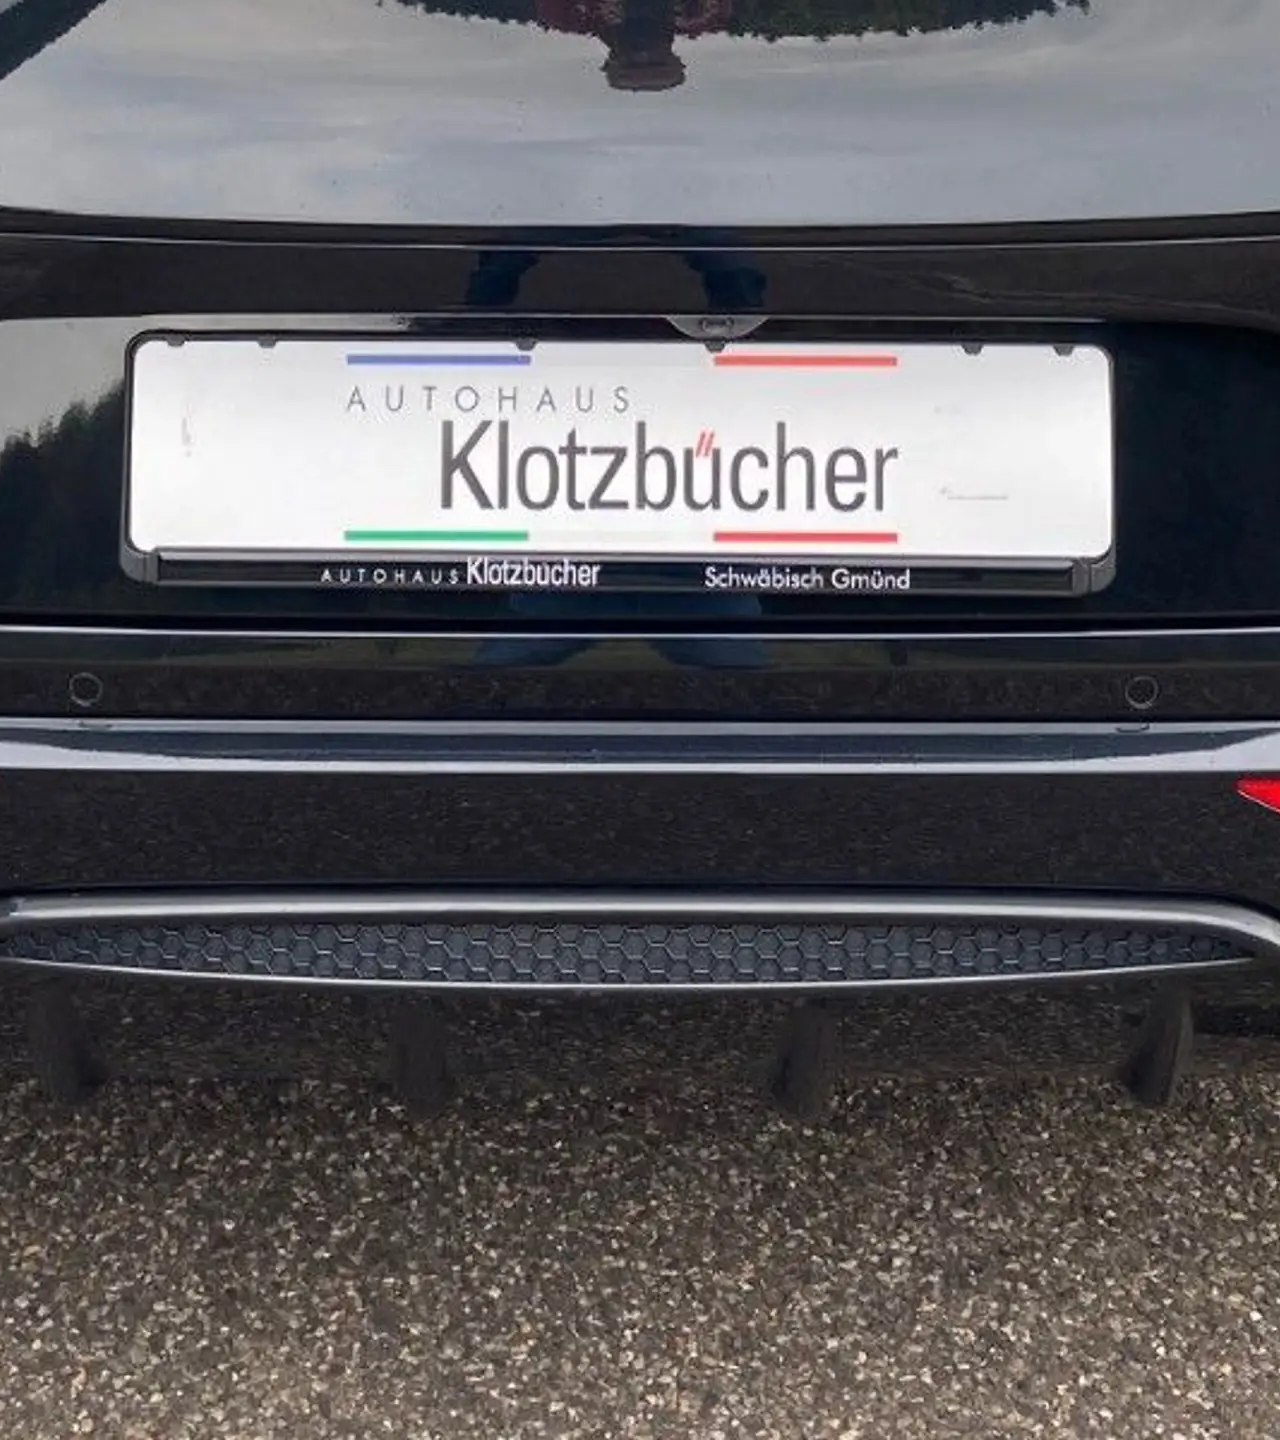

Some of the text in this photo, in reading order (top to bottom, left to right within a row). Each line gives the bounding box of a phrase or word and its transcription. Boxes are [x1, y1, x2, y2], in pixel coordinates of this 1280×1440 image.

[346, 385, 631, 412] AUTOHAUS
[440, 419, 899, 512] Klotzbücher
[320, 568, 459, 585] AUTOHAUS
[703, 565, 911, 590] Schwäbisch Gmünd
